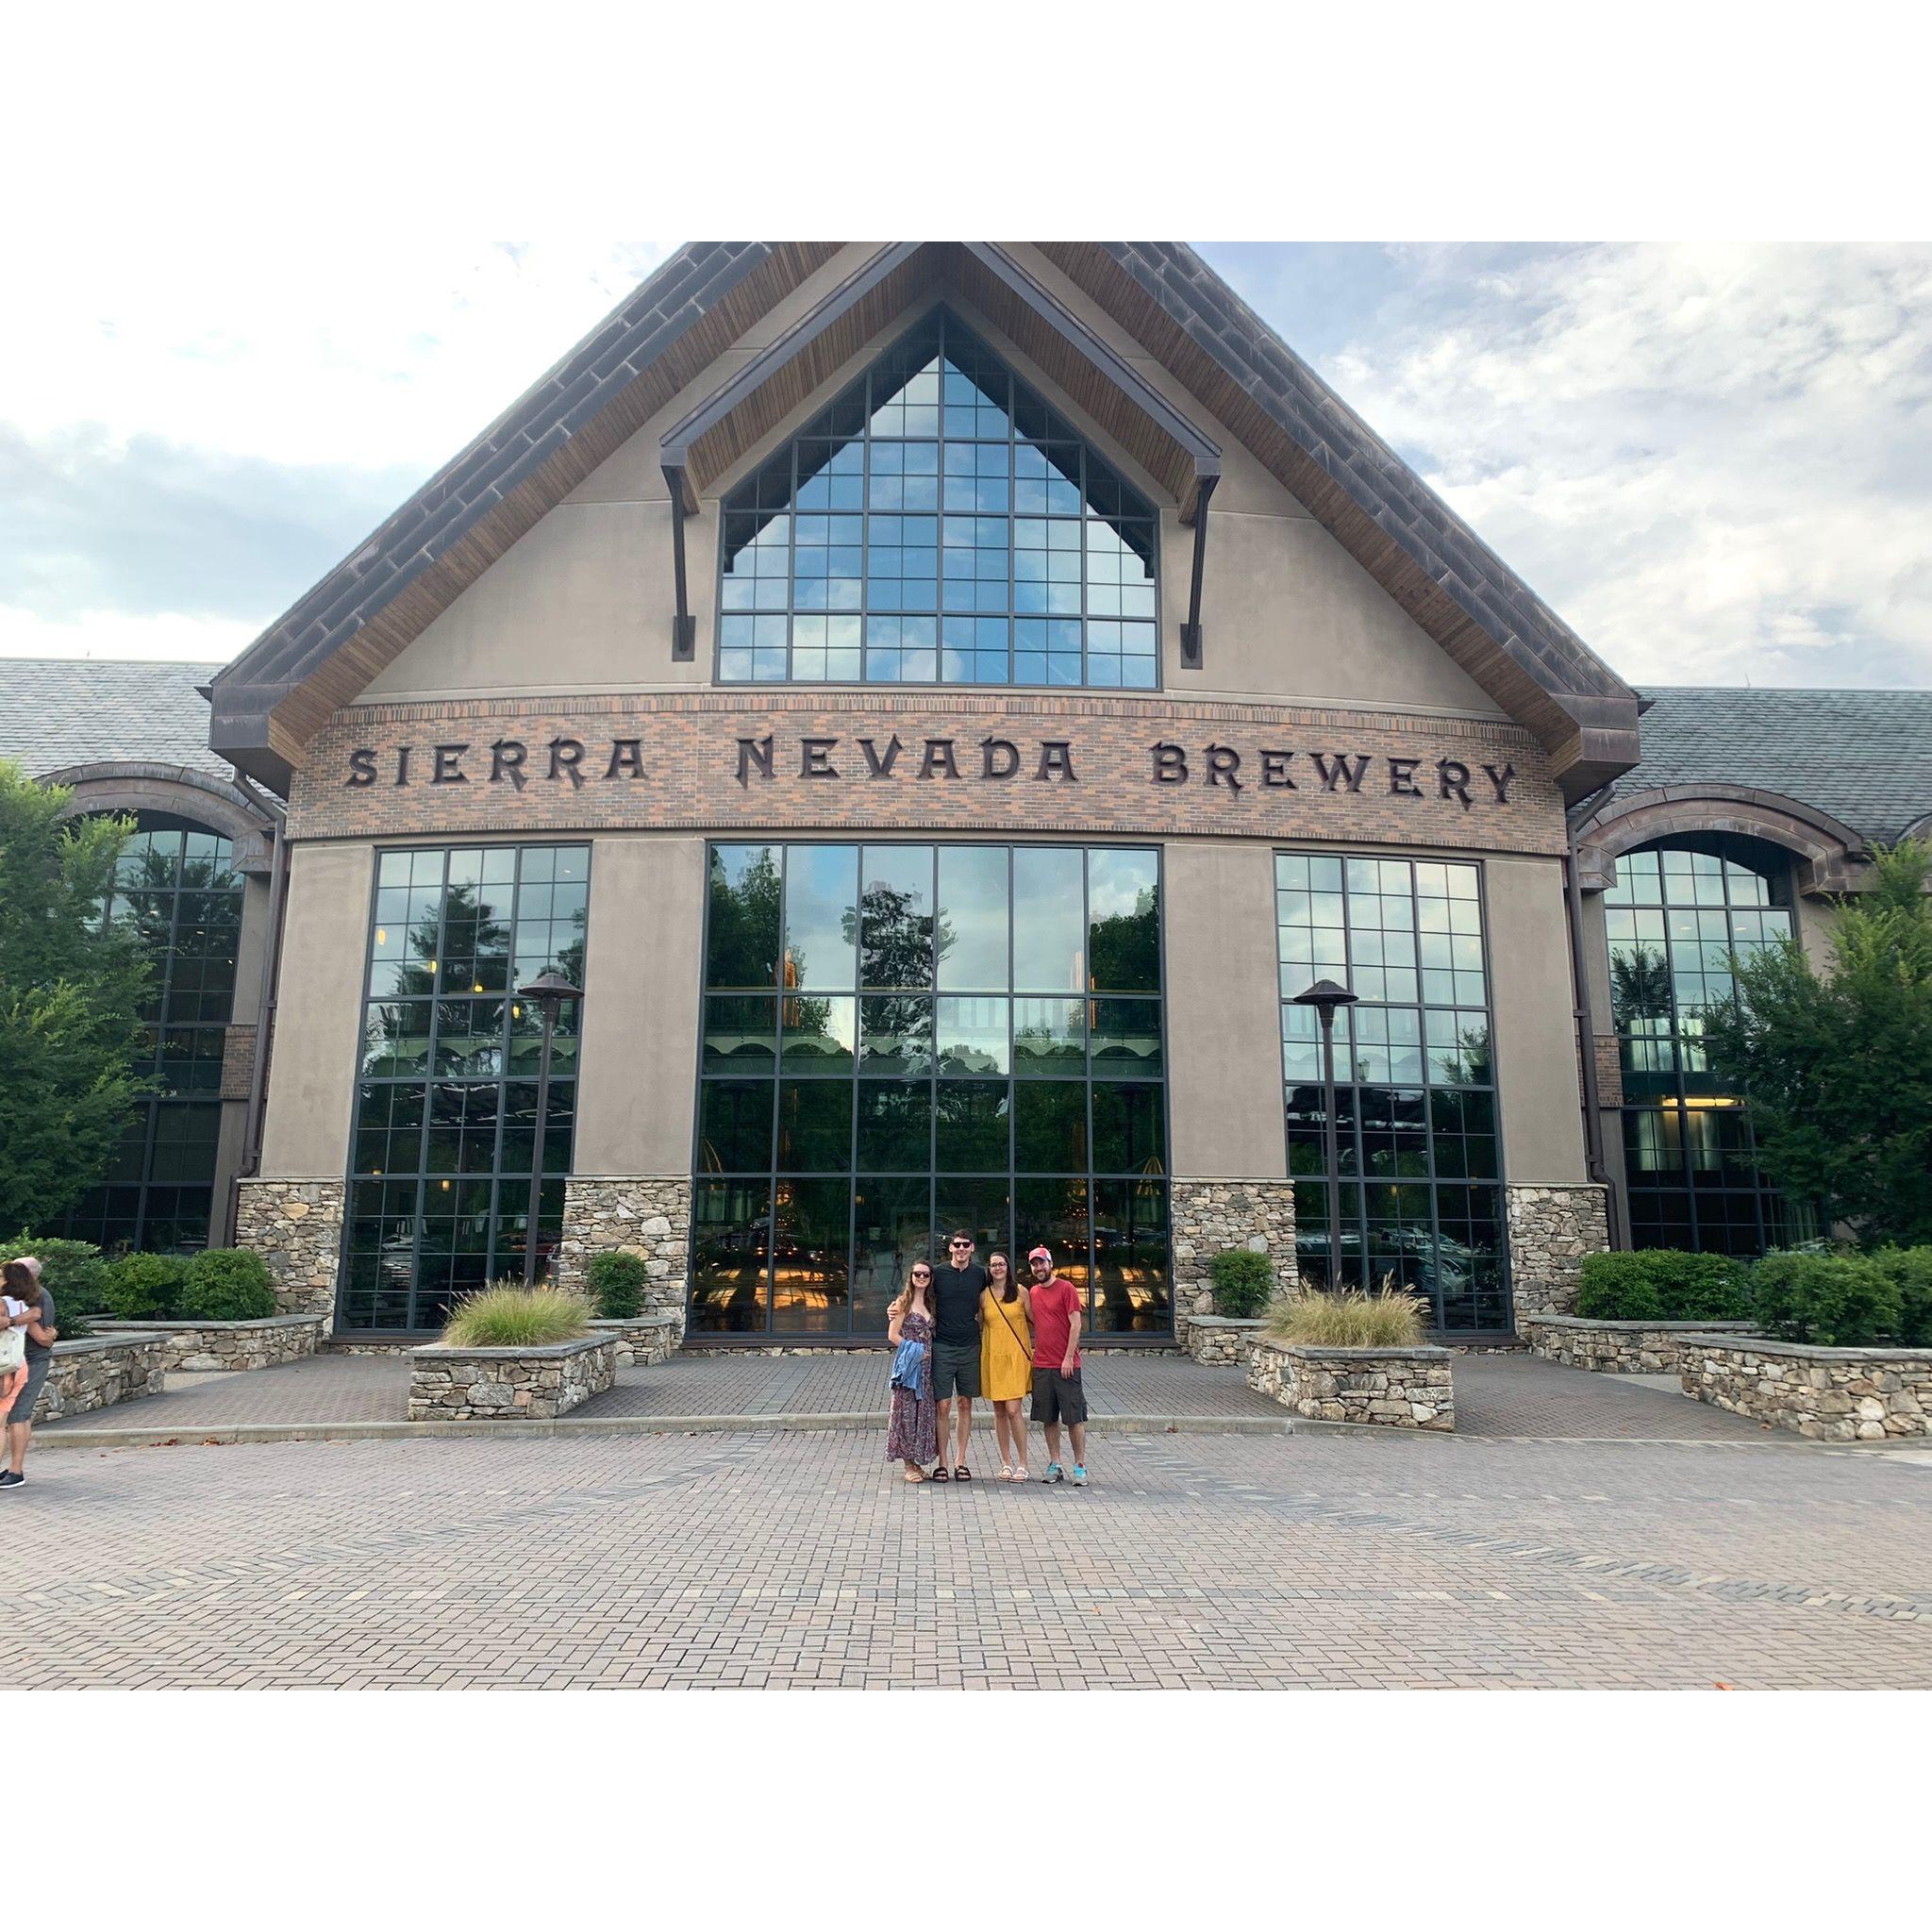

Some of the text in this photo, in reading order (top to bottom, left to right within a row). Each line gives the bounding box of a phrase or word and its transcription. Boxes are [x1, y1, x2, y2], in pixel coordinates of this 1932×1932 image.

[345, 733, 1516, 811] SIERRA NEVADA BREWERY
